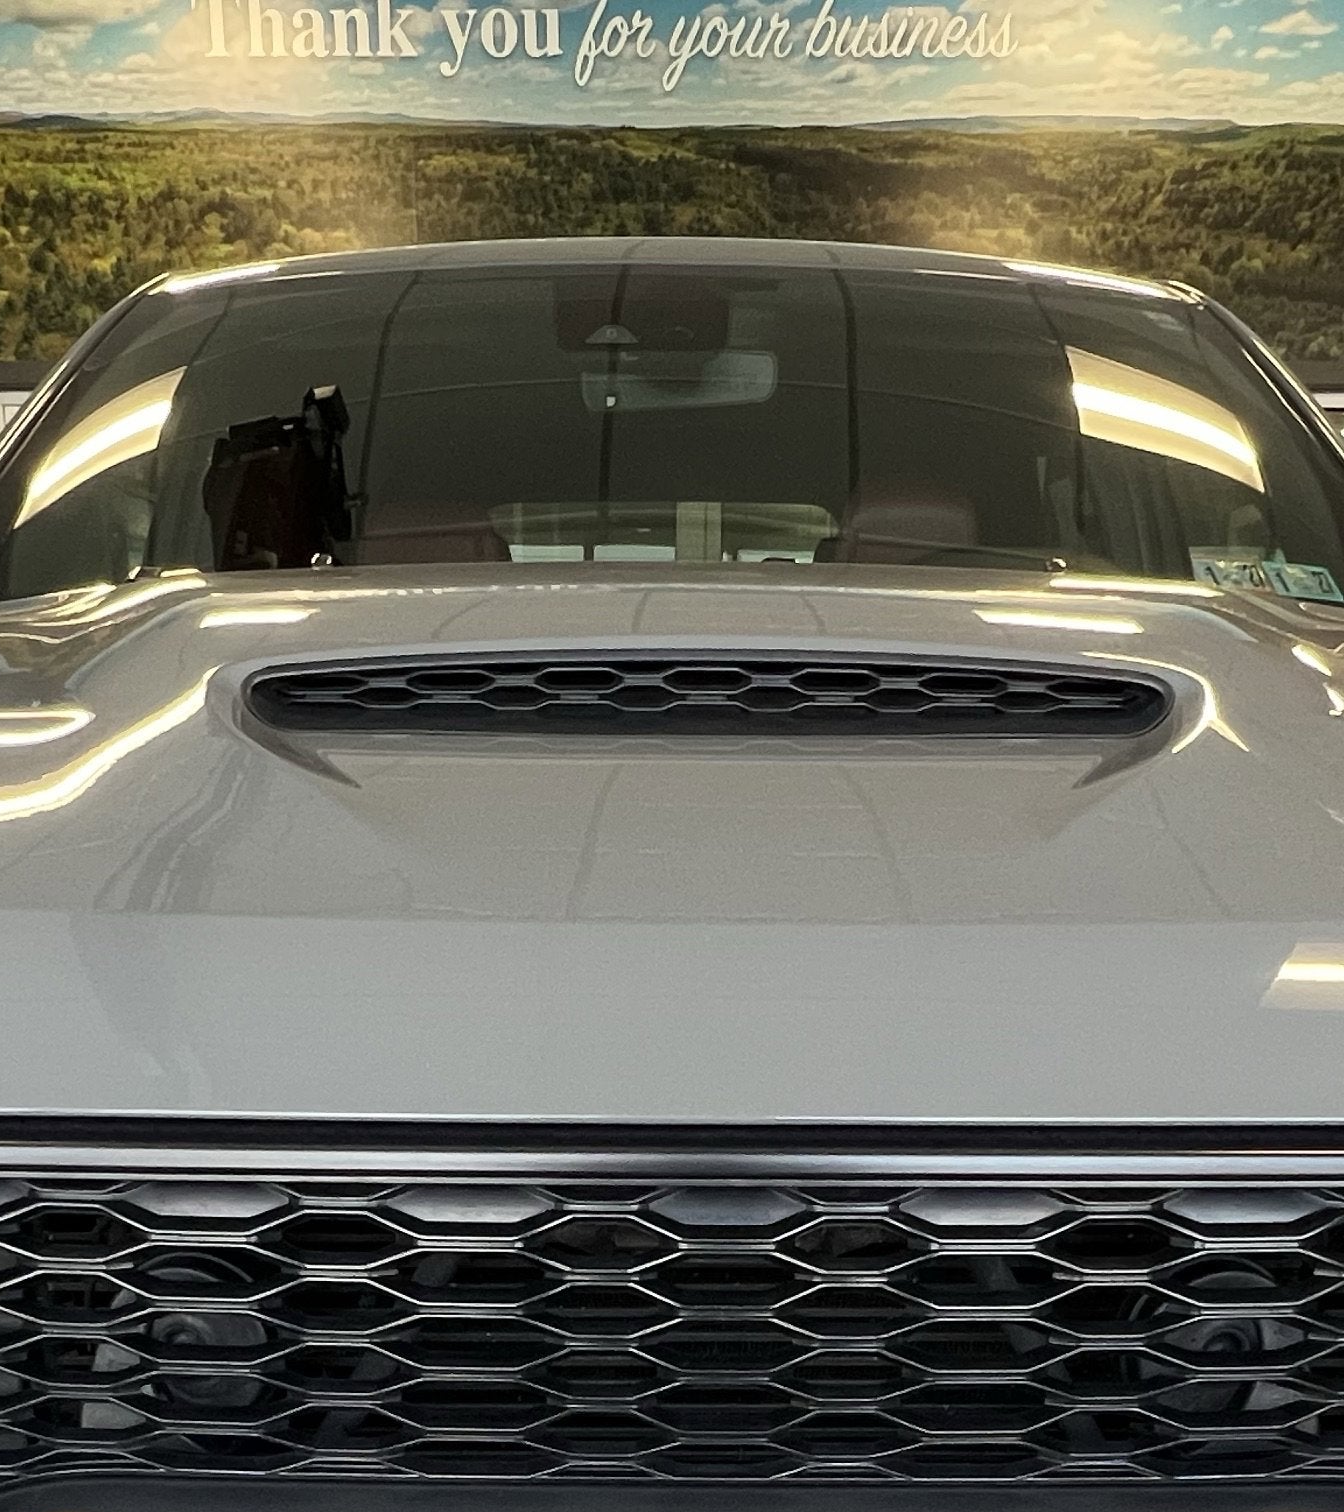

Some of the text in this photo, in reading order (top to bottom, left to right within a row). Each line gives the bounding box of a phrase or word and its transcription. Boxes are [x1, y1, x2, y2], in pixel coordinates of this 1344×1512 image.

[191, 0, 1020, 92] Thank you for your business
